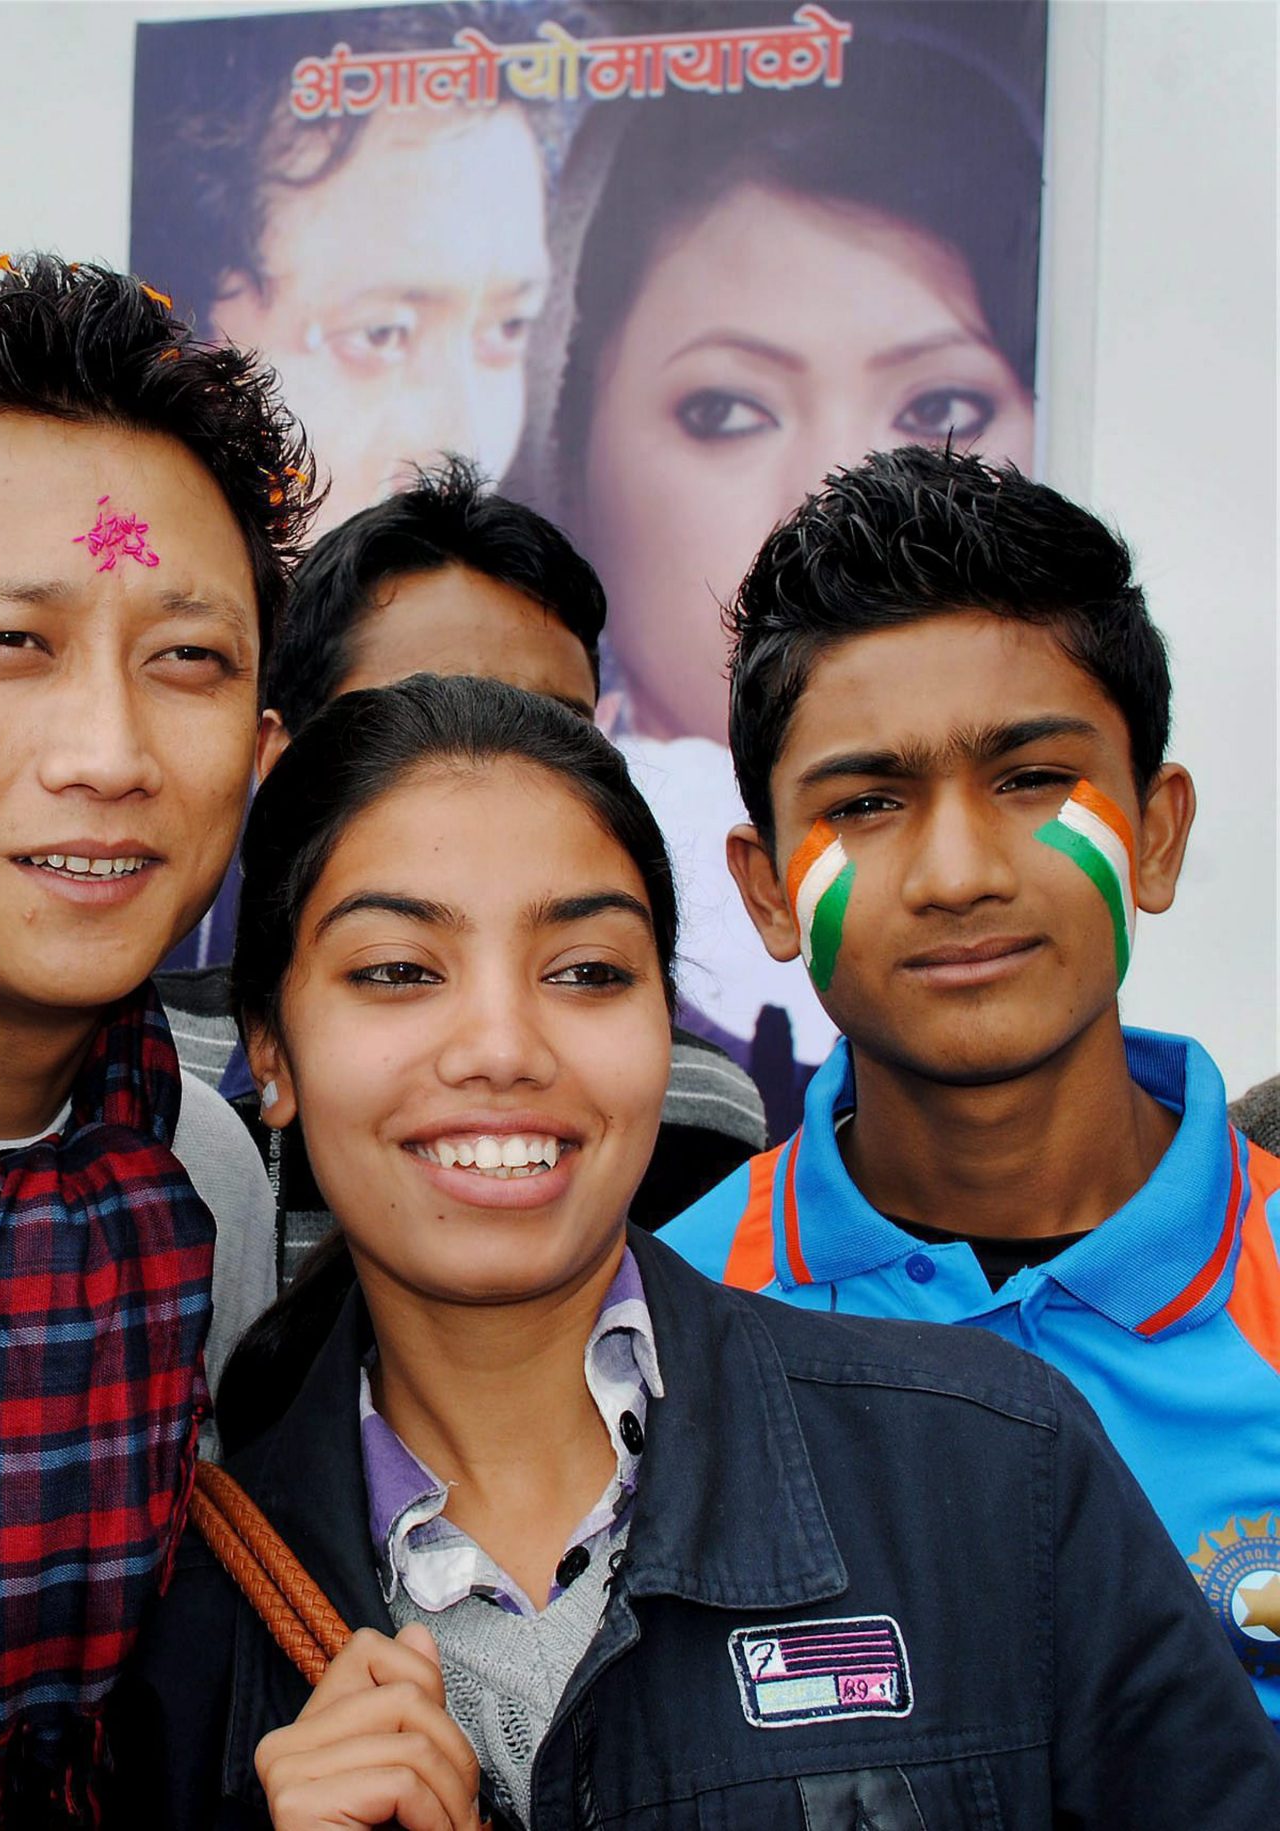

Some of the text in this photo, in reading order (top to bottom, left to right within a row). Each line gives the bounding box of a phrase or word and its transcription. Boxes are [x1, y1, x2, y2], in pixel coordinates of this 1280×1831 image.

[581, 4, 852, 100] मायाको
[269, 1128, 282, 1158] GROU
[1215, 1548, 1270, 1582] CONTROL
